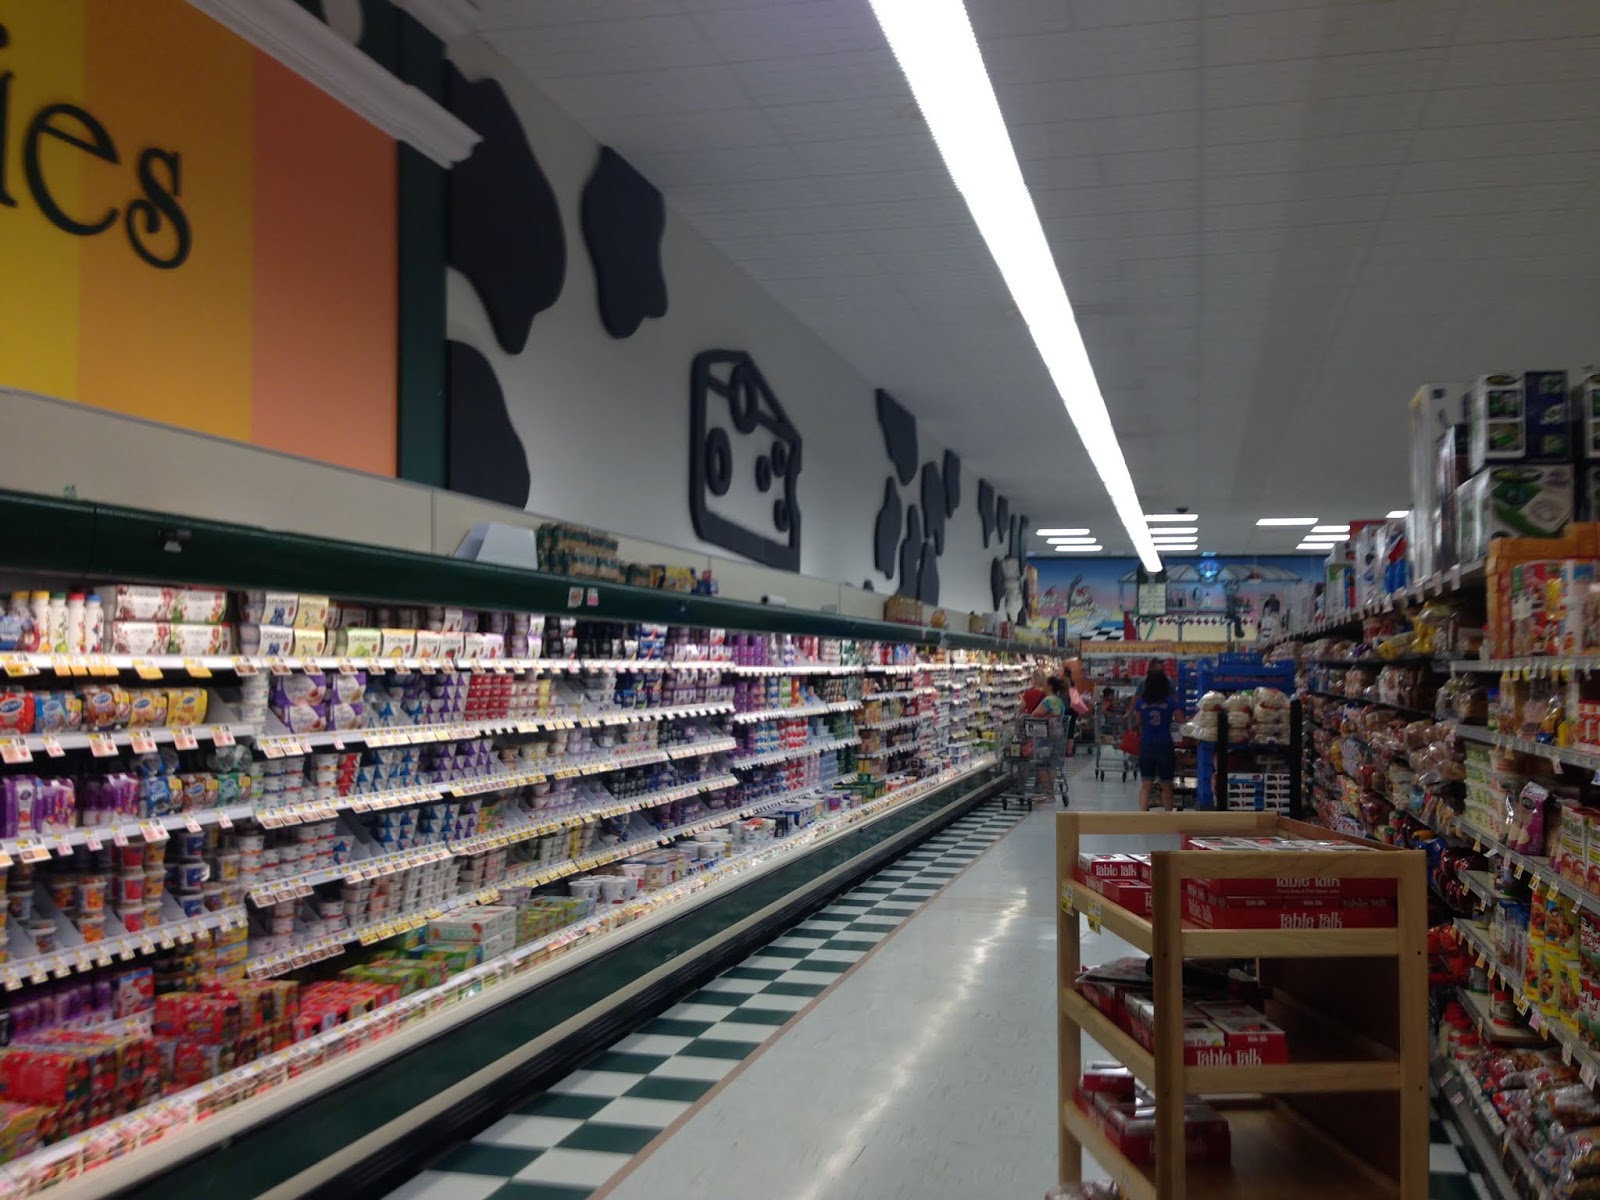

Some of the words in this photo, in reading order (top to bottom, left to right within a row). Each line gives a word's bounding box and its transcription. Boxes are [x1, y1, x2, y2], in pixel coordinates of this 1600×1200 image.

[1095, 863, 1118, 877] Table
[1121, 863, 1137, 877] Talk
[1280, 912, 1314, 929] Table
[1318, 912, 1343, 929] Talk
[1196, 1048, 1232, 1066] Table
[1236, 1048, 1262, 1066] Talk
